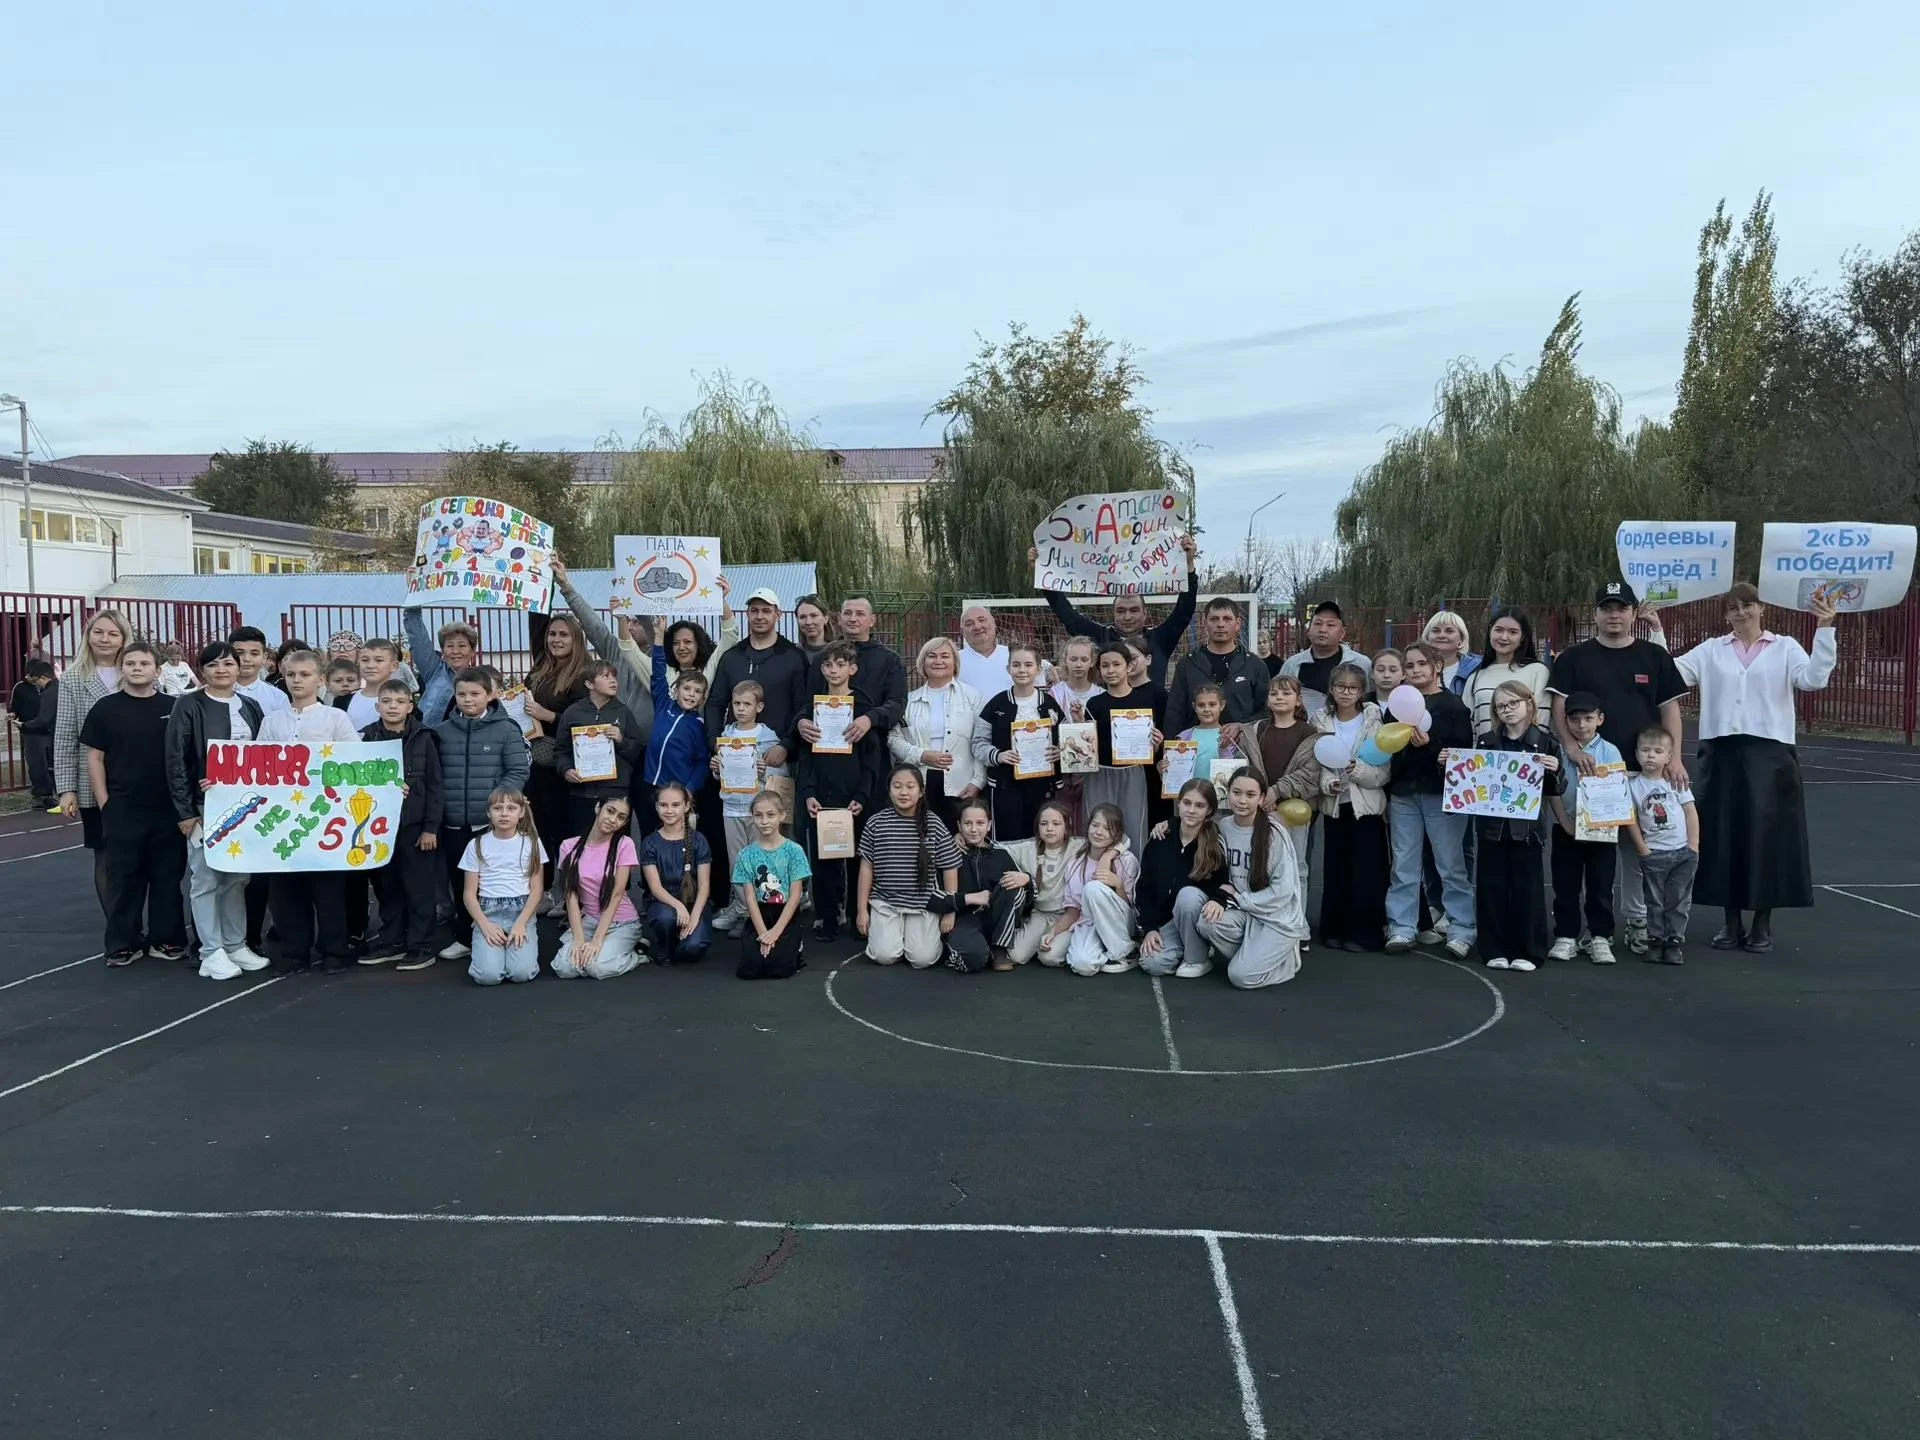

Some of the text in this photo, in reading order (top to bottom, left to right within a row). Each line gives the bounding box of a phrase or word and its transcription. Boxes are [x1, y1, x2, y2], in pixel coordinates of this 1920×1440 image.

[440, 498, 505, 519] СЕГОДНЯ
[646, 537, 686, 551] ПАПА
[1806, 528, 1870, 548] 2«Б»
[1041, 547, 1074, 568] Мы
[1081, 551, 1133, 574] сегодня
[1776, 551, 1894, 575] победит!
[464, 571, 523, 594] ПРИШЛИ
